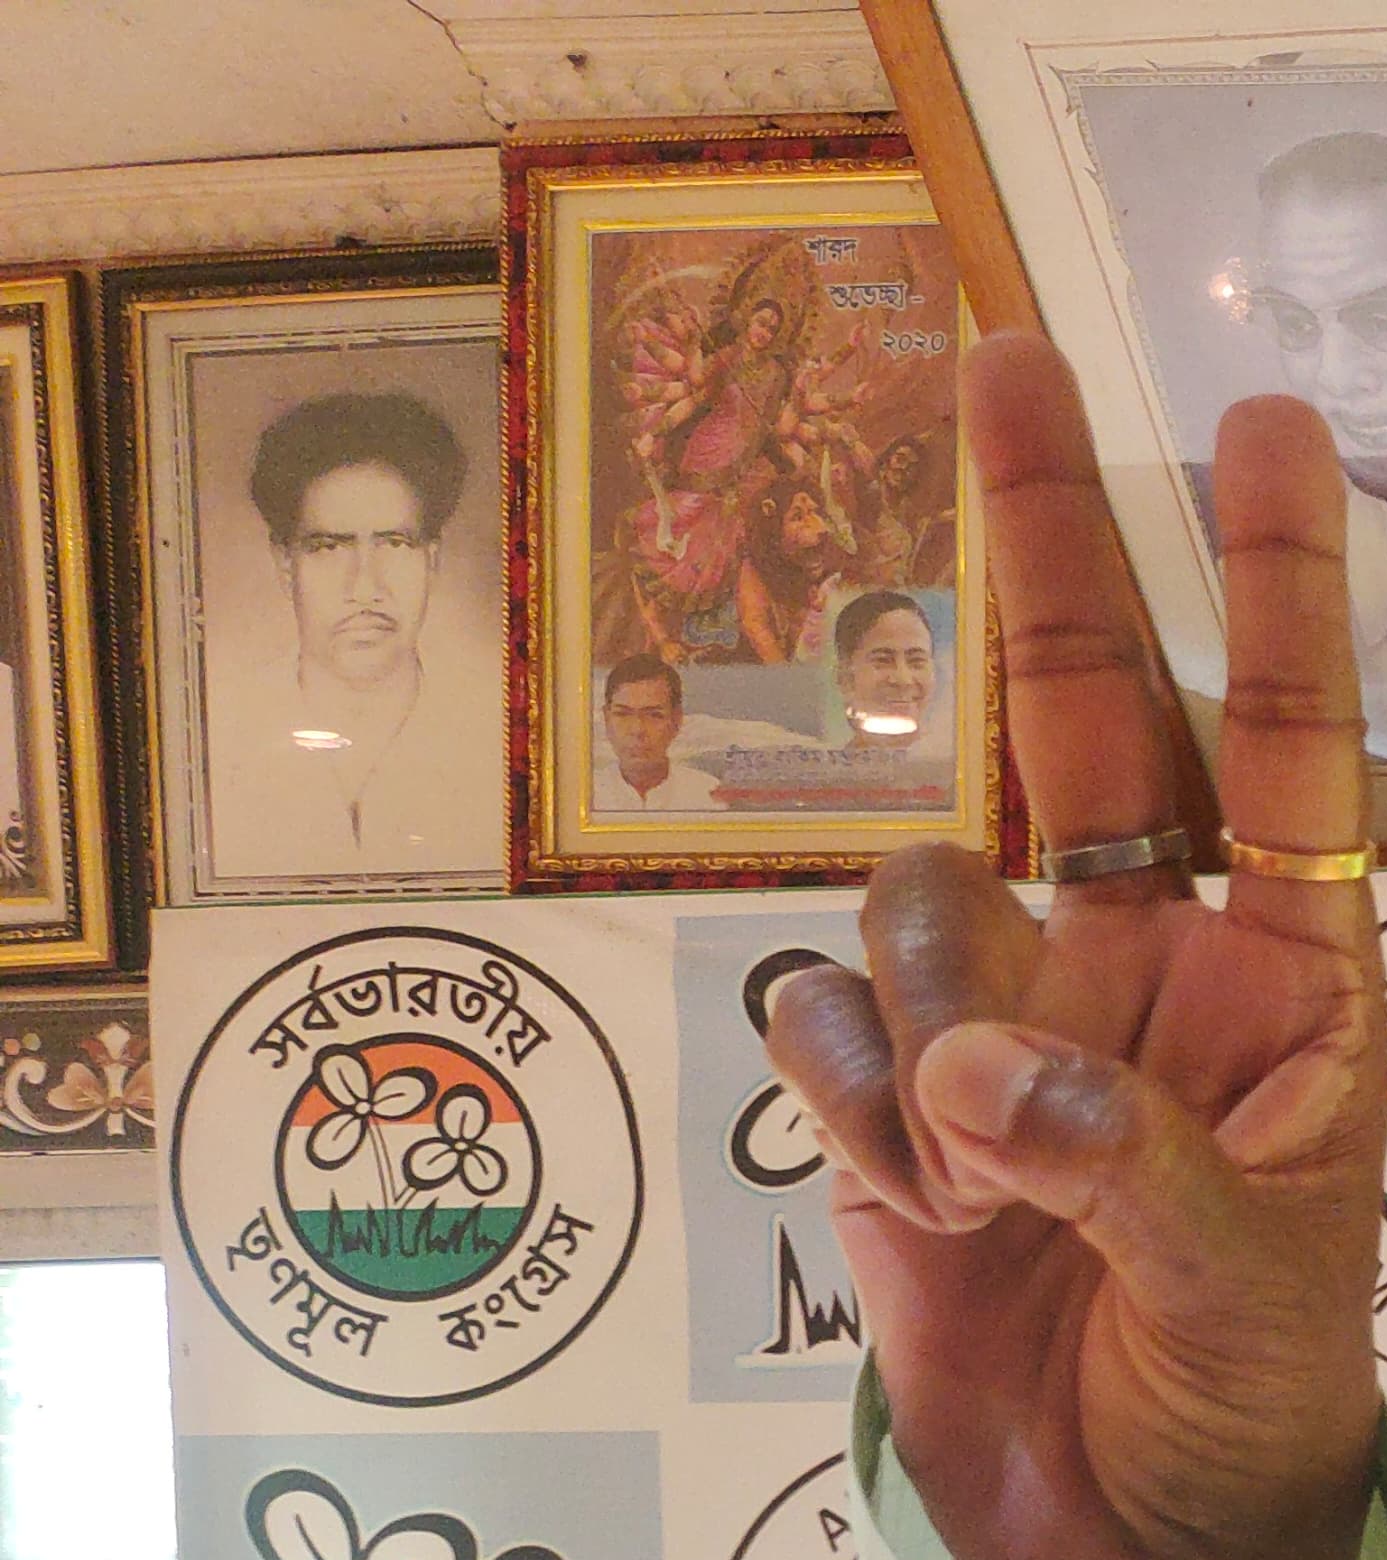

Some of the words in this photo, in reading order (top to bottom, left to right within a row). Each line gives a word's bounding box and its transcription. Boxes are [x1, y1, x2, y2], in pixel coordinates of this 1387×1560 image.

[882, 331, 945, 356] ২০২০
[248, 960, 552, 1069] সর্বভারতীয়
[225, 1206, 389, 1357] তৃণমূল
[438, 1202, 595, 1353] কংগ্রেস
